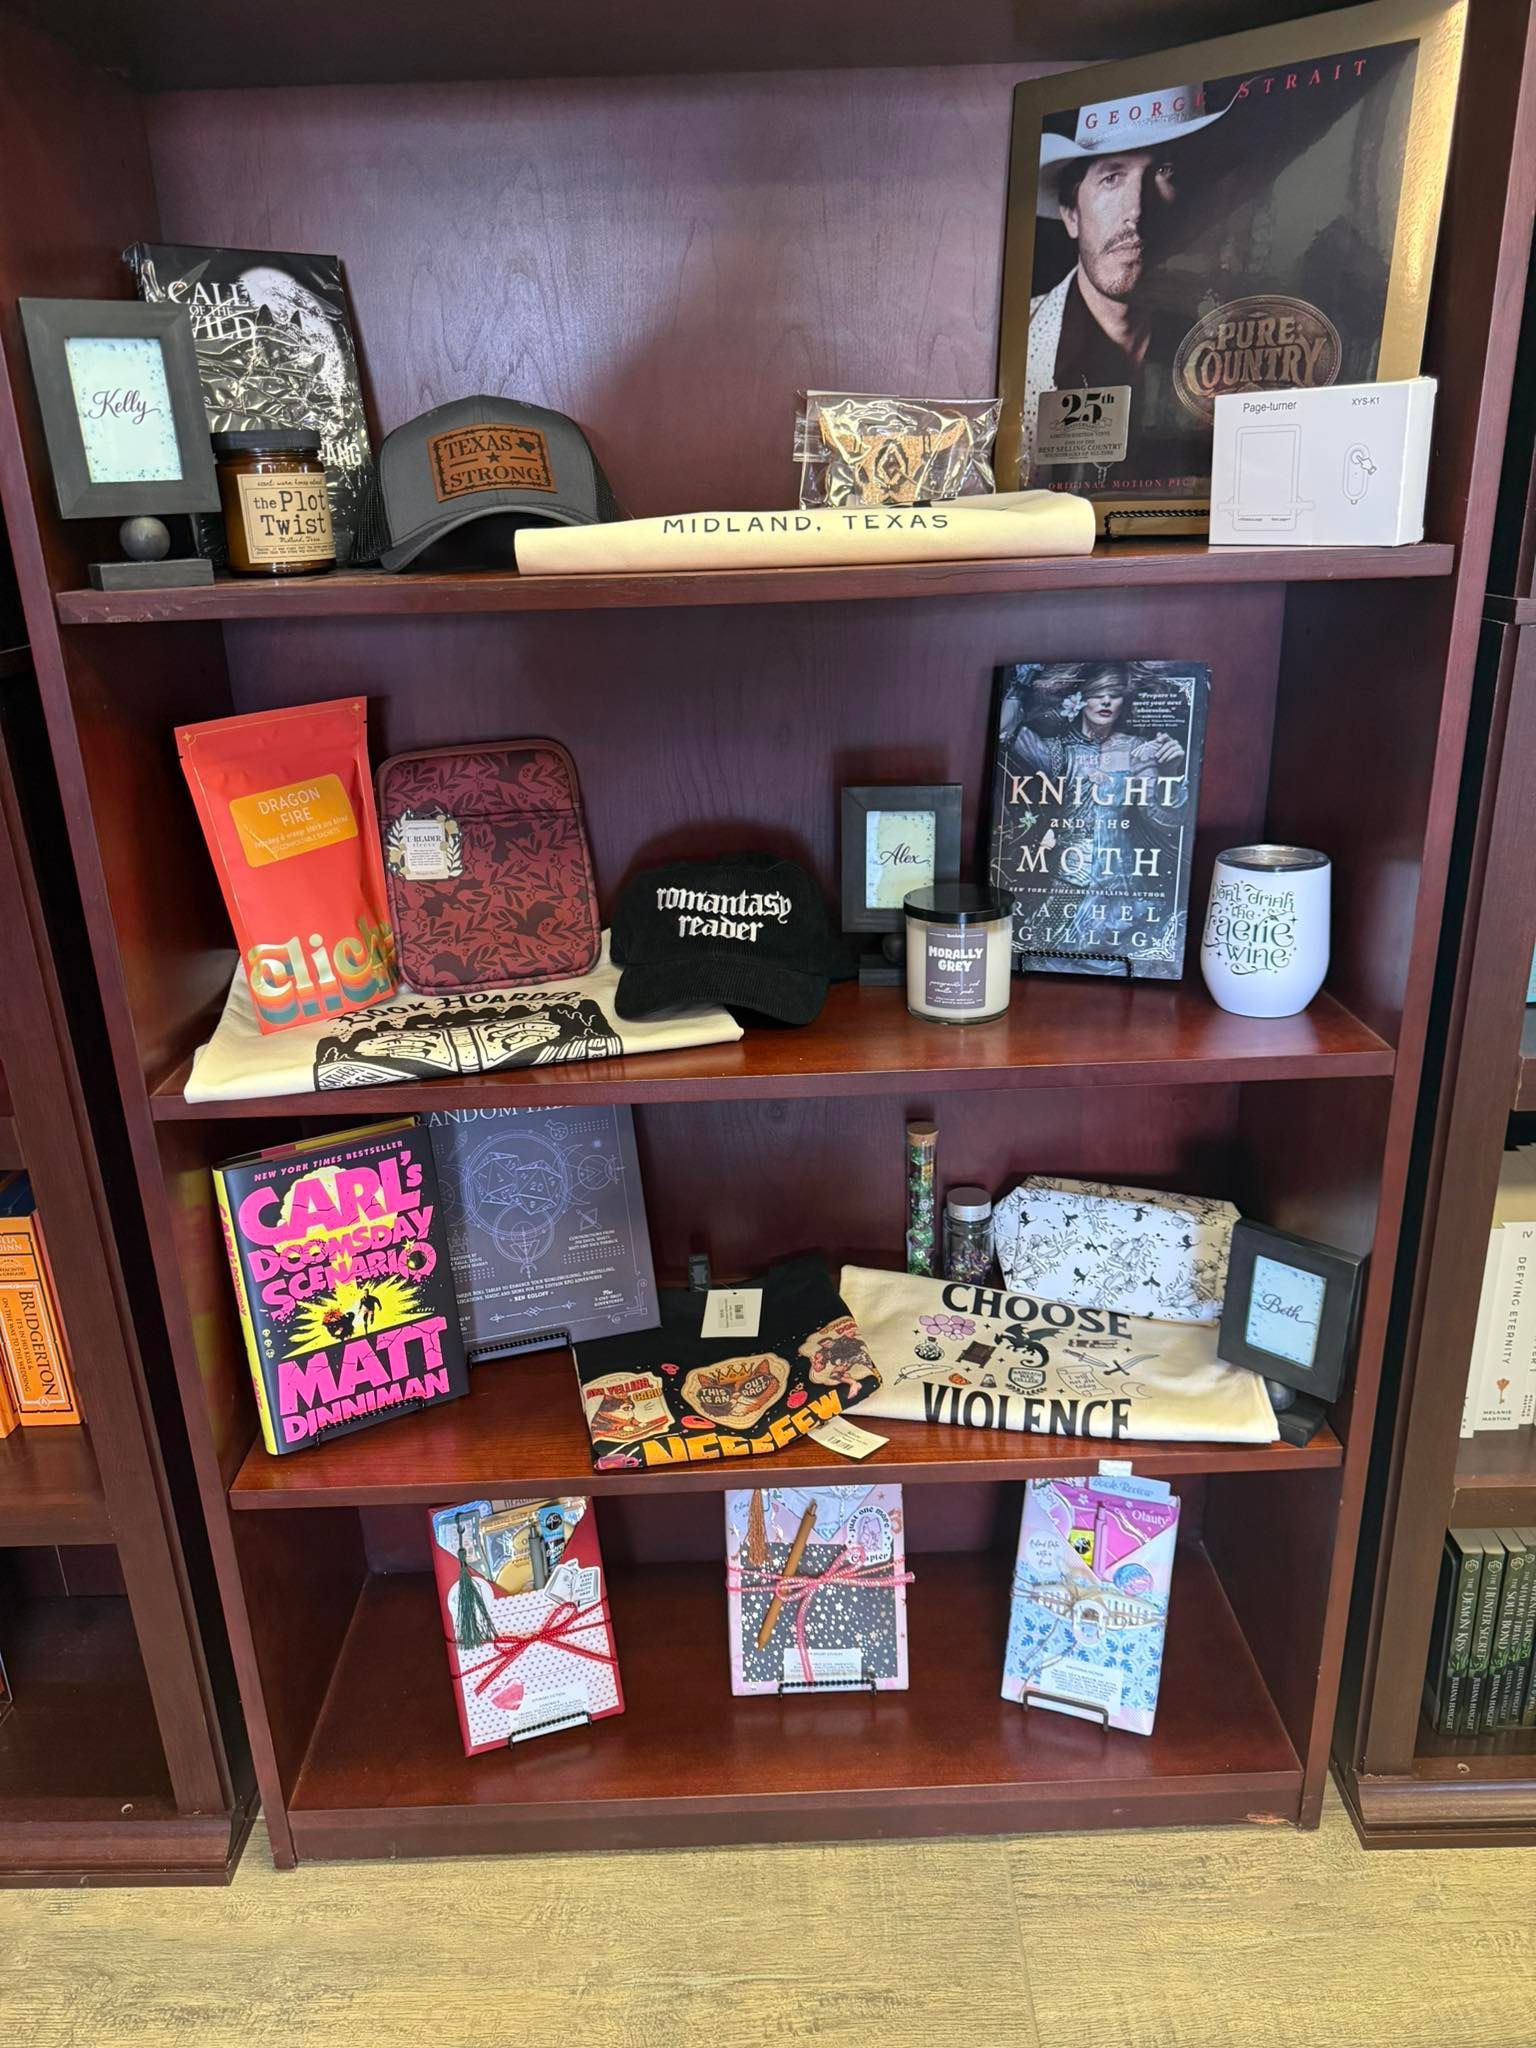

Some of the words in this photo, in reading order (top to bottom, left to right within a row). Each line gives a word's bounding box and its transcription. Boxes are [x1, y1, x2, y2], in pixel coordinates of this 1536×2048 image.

[1085, 90, 1206, 130] GEORGE
[1237, 58, 1367, 101] STRAIT
[168, 280, 250, 307] CALL
[210, 307, 232, 316] THE
[1218, 316, 1296, 350] PURE
[1183, 337, 1327, 397] COUNTRY
[87, 387, 162, 425] Kelly
[1061, 391, 1115, 427] 25th
[1242, 400, 1297, 415] Page-turner
[1351, 396, 1381, 407] XYS-K1
[444, 434, 513, 460] TEXAS
[449, 465, 541, 488] STRONG
[1049, 481, 1105, 491] ORIGINAL
[1112, 479, 1162, 489] MOTION
[253, 497, 277, 510] the
[279, 490, 326, 512] Plot
[260, 512, 326, 536] Twist
[663, 514, 822, 536] MIDLAND,
[843, 512, 950, 532] TEXAS
[257, 786, 321, 816] DRAGON
[1008, 771, 1187, 807] KNIGHT
[280, 806, 314, 827] FIRE
[877, 843, 932, 868] Alex
[1016, 844, 1162, 878] MOTH
[656, 886, 793, 924] romantasy
[1076, 889, 1129, 897] BESTSELLING
[678, 914, 765, 942] reader
[1018, 926, 1148, 947] GILLIG
[928, 945, 984, 960] MORALLY
[938, 959, 973, 973] GREY
[329, 1001, 426, 1027] BOOK
[437, 990, 582, 1010] HOARDER
[254, 1170, 277, 1182] NEW
[281, 1163, 309, 1176] YORK
[313, 1155, 343, 1168] TIMES
[346, 1140, 403, 1160] BESTSELLER
[529, 1180, 545, 1192] 20
[247, 1206, 435, 1283] DOOMSDAY
[261, 1241, 437, 1321] SCENARIO
[1511, 1256, 1527, 1306] DEFYING
[2, 1298, 10, 1309] ON
[5, 1309, 13, 1322] THE
[942, 1281, 1133, 1340] CHOOSE
[1258, 1292, 1316, 1326] Beth
[12, 1338, 19, 1346] TO
[18, 1330, 25, 1338] IN
[19, 1291, 59, 1396] BRIDGERTON
[21, 1338, 29, 1351] HIS
[1502, 1311, 1519, 1364] ETERNITY
[14, 1347, 22, 1357] THE
[18, 1356, 32, 1393] WEDDING
[277, 1316, 449, 1416] MATT
[702, 1388, 727, 1397] THIS
[744, 1376, 764, 1390] OUT
[282, 1368, 450, 1443] DINNIMAN
[700, 1396, 713, 1404] IS
[714, 1395, 730, 1404] AN
[922, 1381, 1134, 1442] VIOLENCE
[1459, 1591, 1475, 1629] DEMON
[1481, 1586, 1497, 1625] HUNTER
[1503, 1591, 1518, 1617] SOUL
[1455, 1632, 1469, 1652] KISS
[1498, 1620, 1513, 1650] BOND
